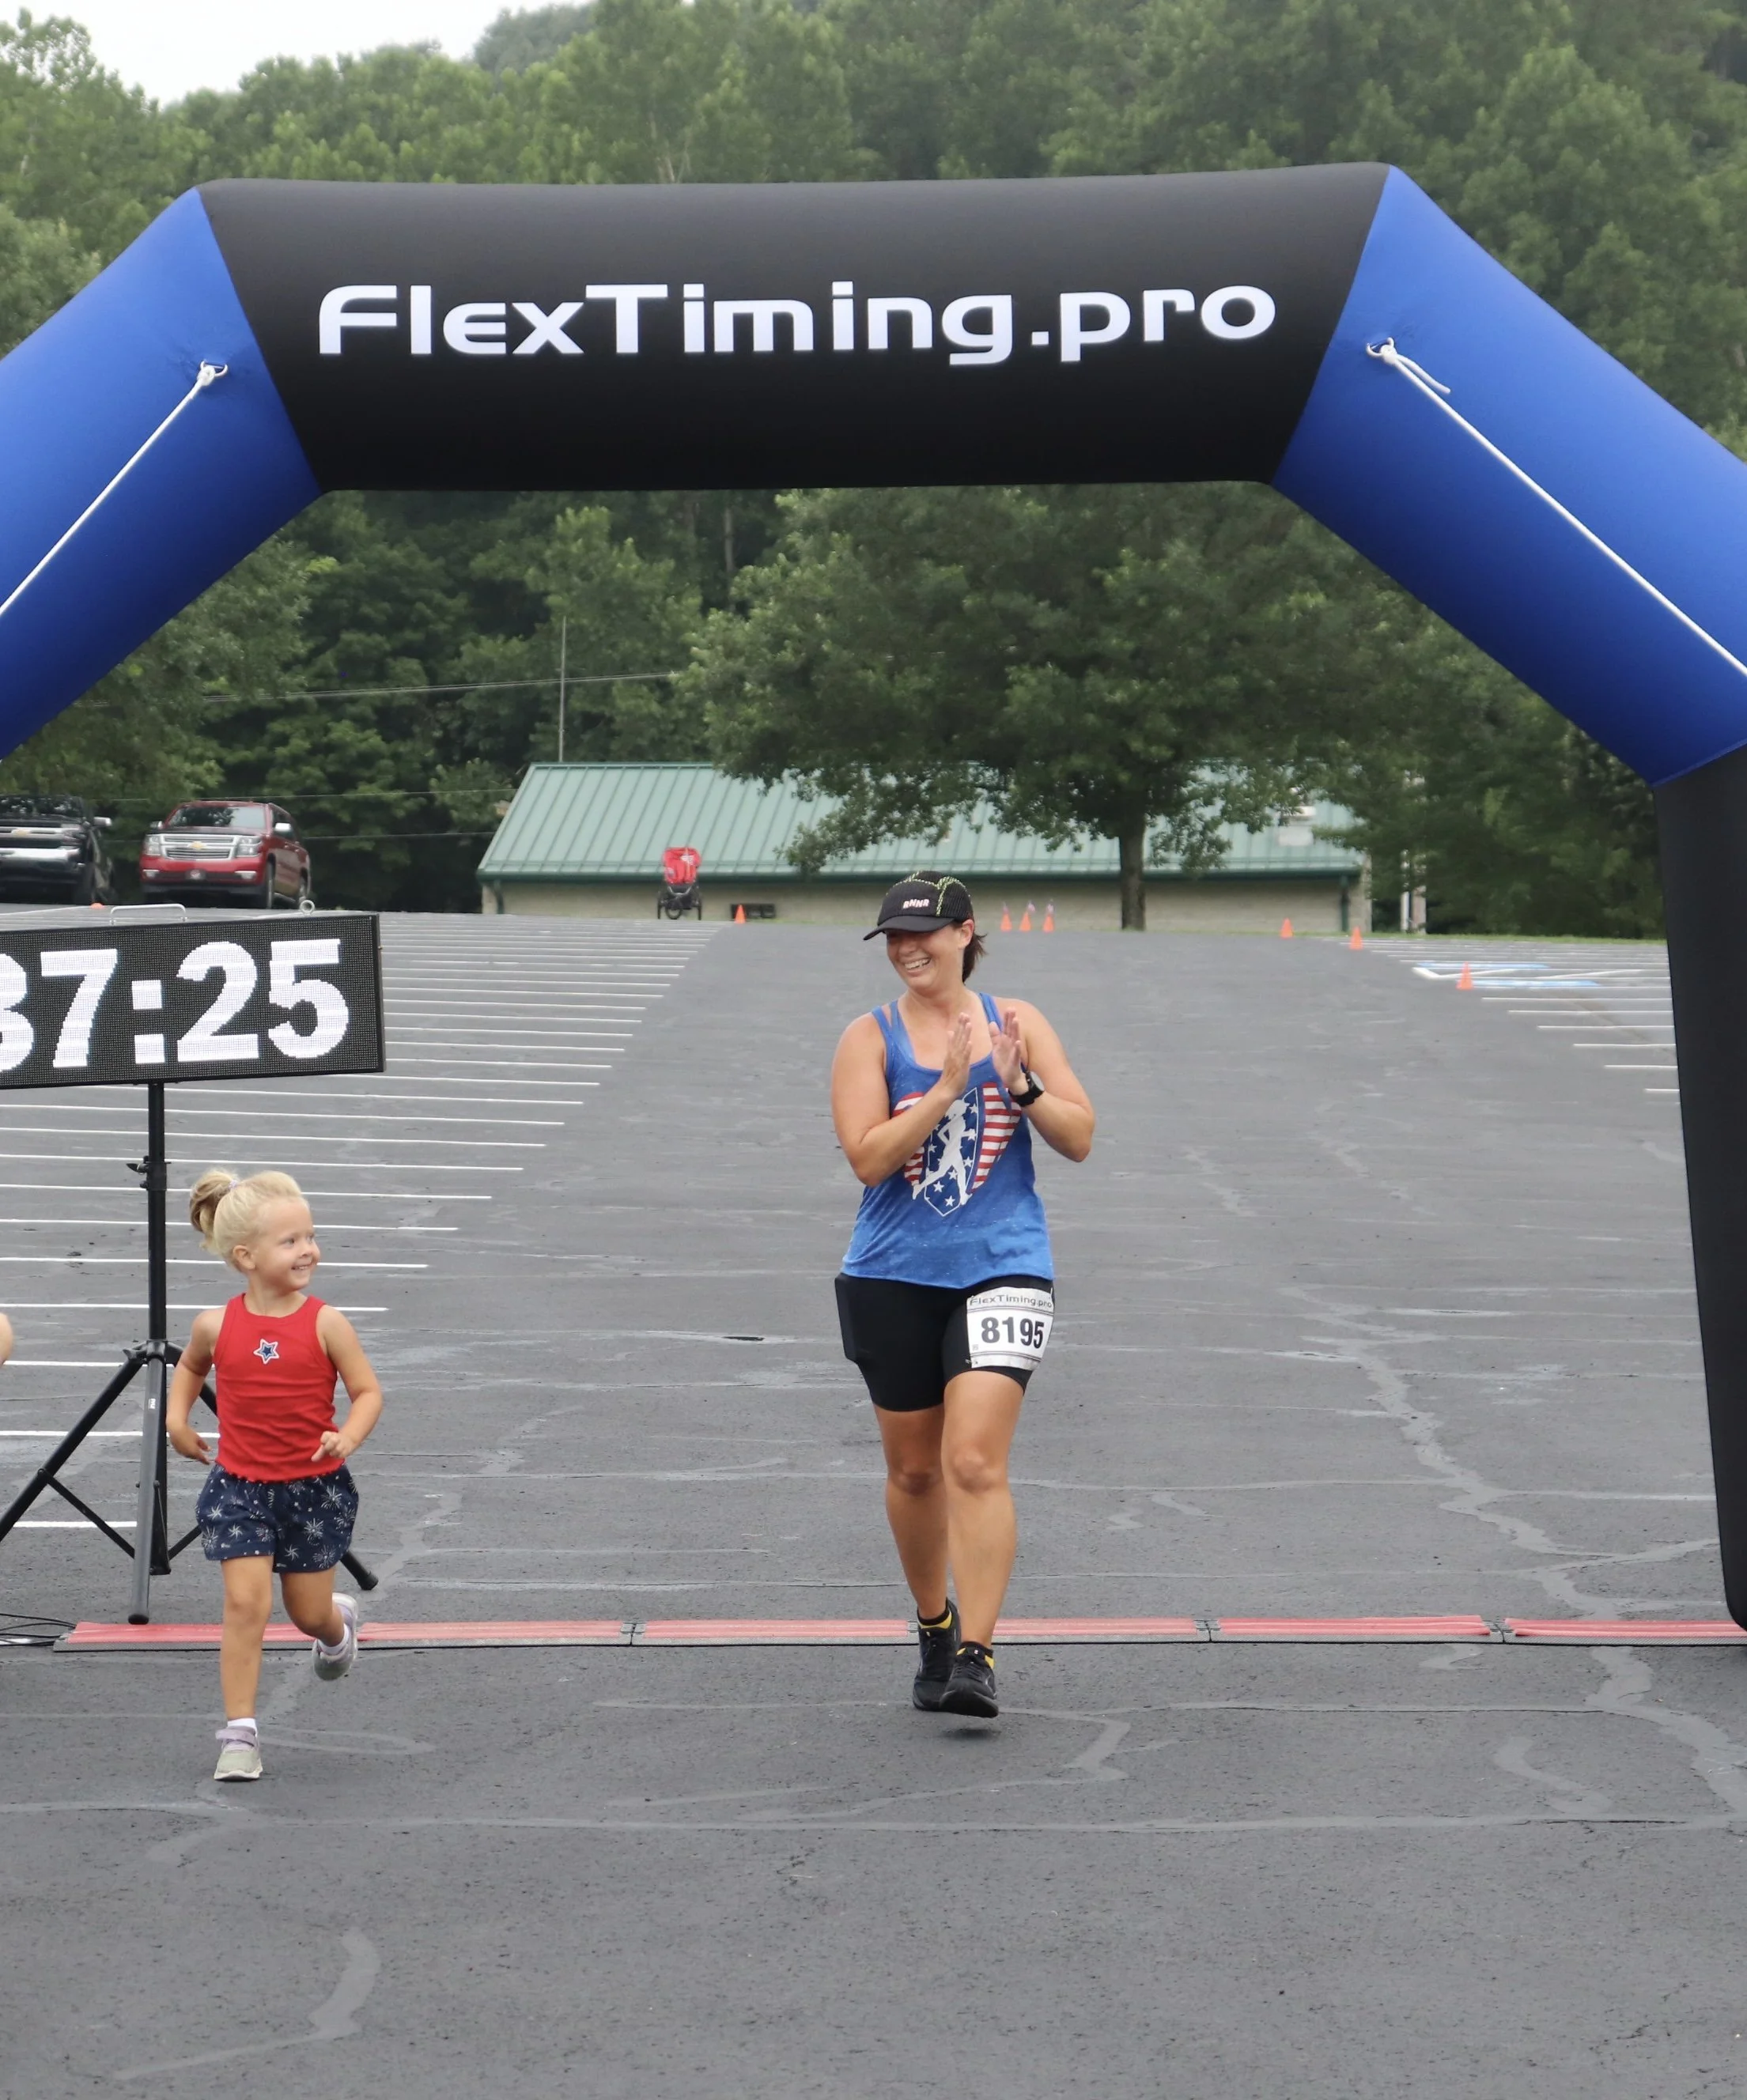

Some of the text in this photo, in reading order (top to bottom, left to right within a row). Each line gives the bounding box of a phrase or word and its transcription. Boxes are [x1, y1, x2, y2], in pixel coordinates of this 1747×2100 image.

[318, 281, 1276, 365] FlexTiming.pro
[970, 1294, 1053, 1308] FlexTiming.pro
[981, 1316, 1045, 1349] 8195
